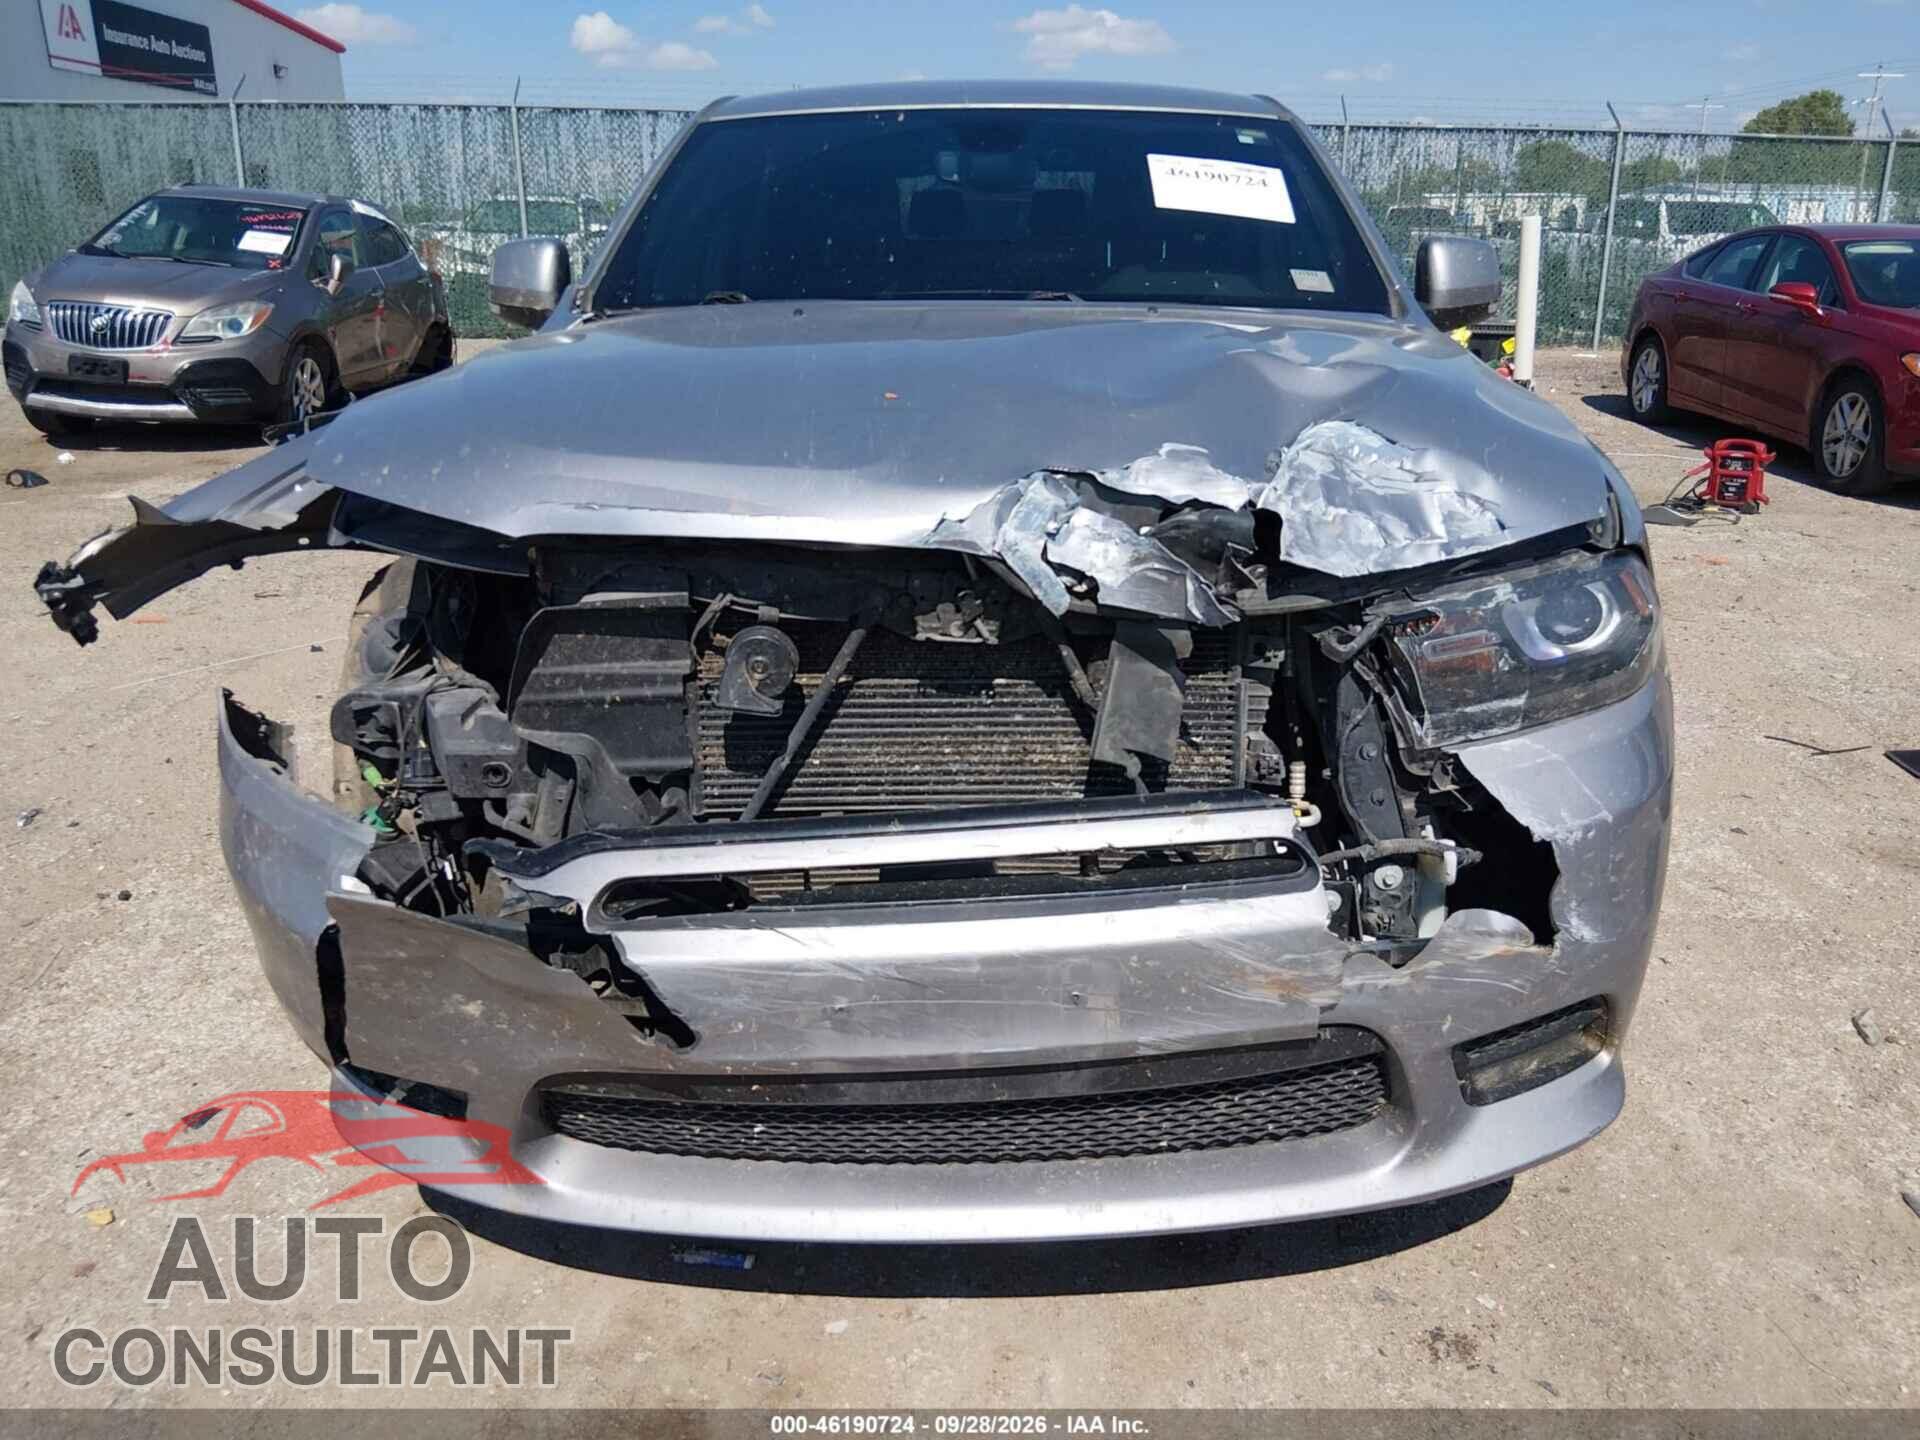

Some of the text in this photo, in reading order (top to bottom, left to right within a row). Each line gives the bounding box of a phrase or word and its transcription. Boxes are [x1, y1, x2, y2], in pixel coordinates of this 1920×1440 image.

[102, 23, 207, 64] Insurance Auto Auctions
[1164, 167, 1269, 188] 46190724
